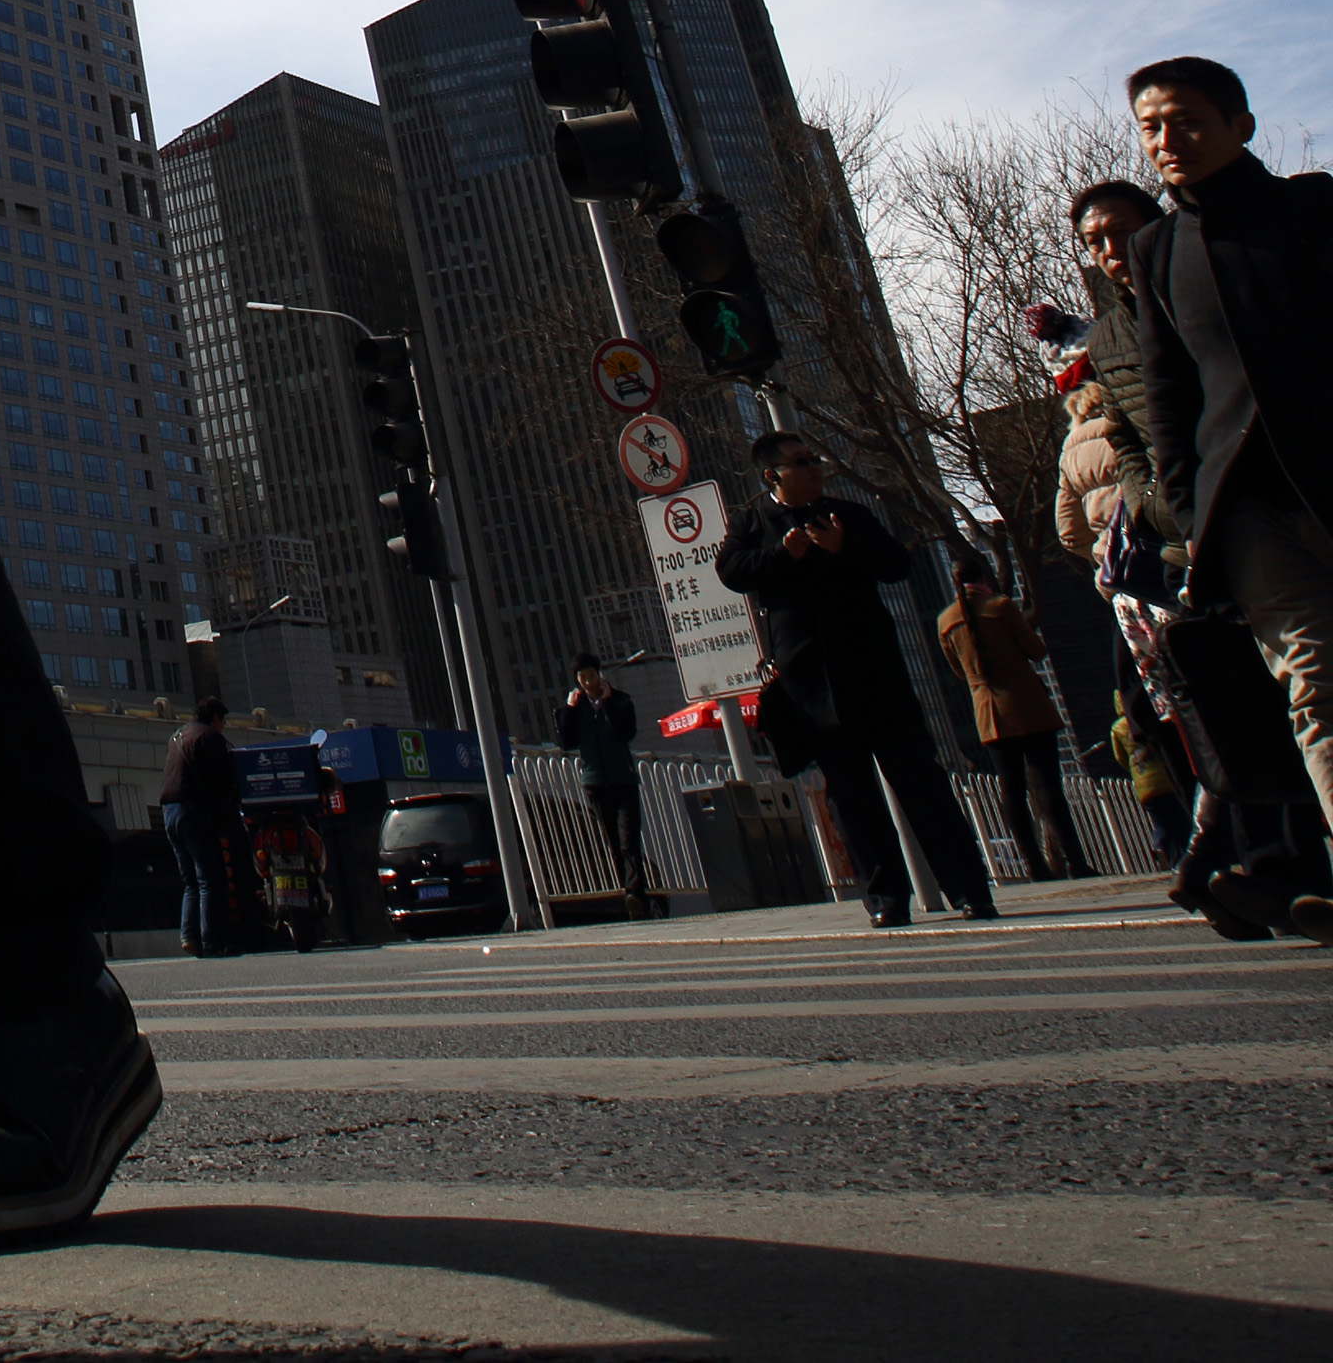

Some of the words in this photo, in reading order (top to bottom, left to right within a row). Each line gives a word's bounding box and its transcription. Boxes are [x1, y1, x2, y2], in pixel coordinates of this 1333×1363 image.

[664, 577, 700, 603] 摩托车
[317, 746, 351, 762] 国移动
